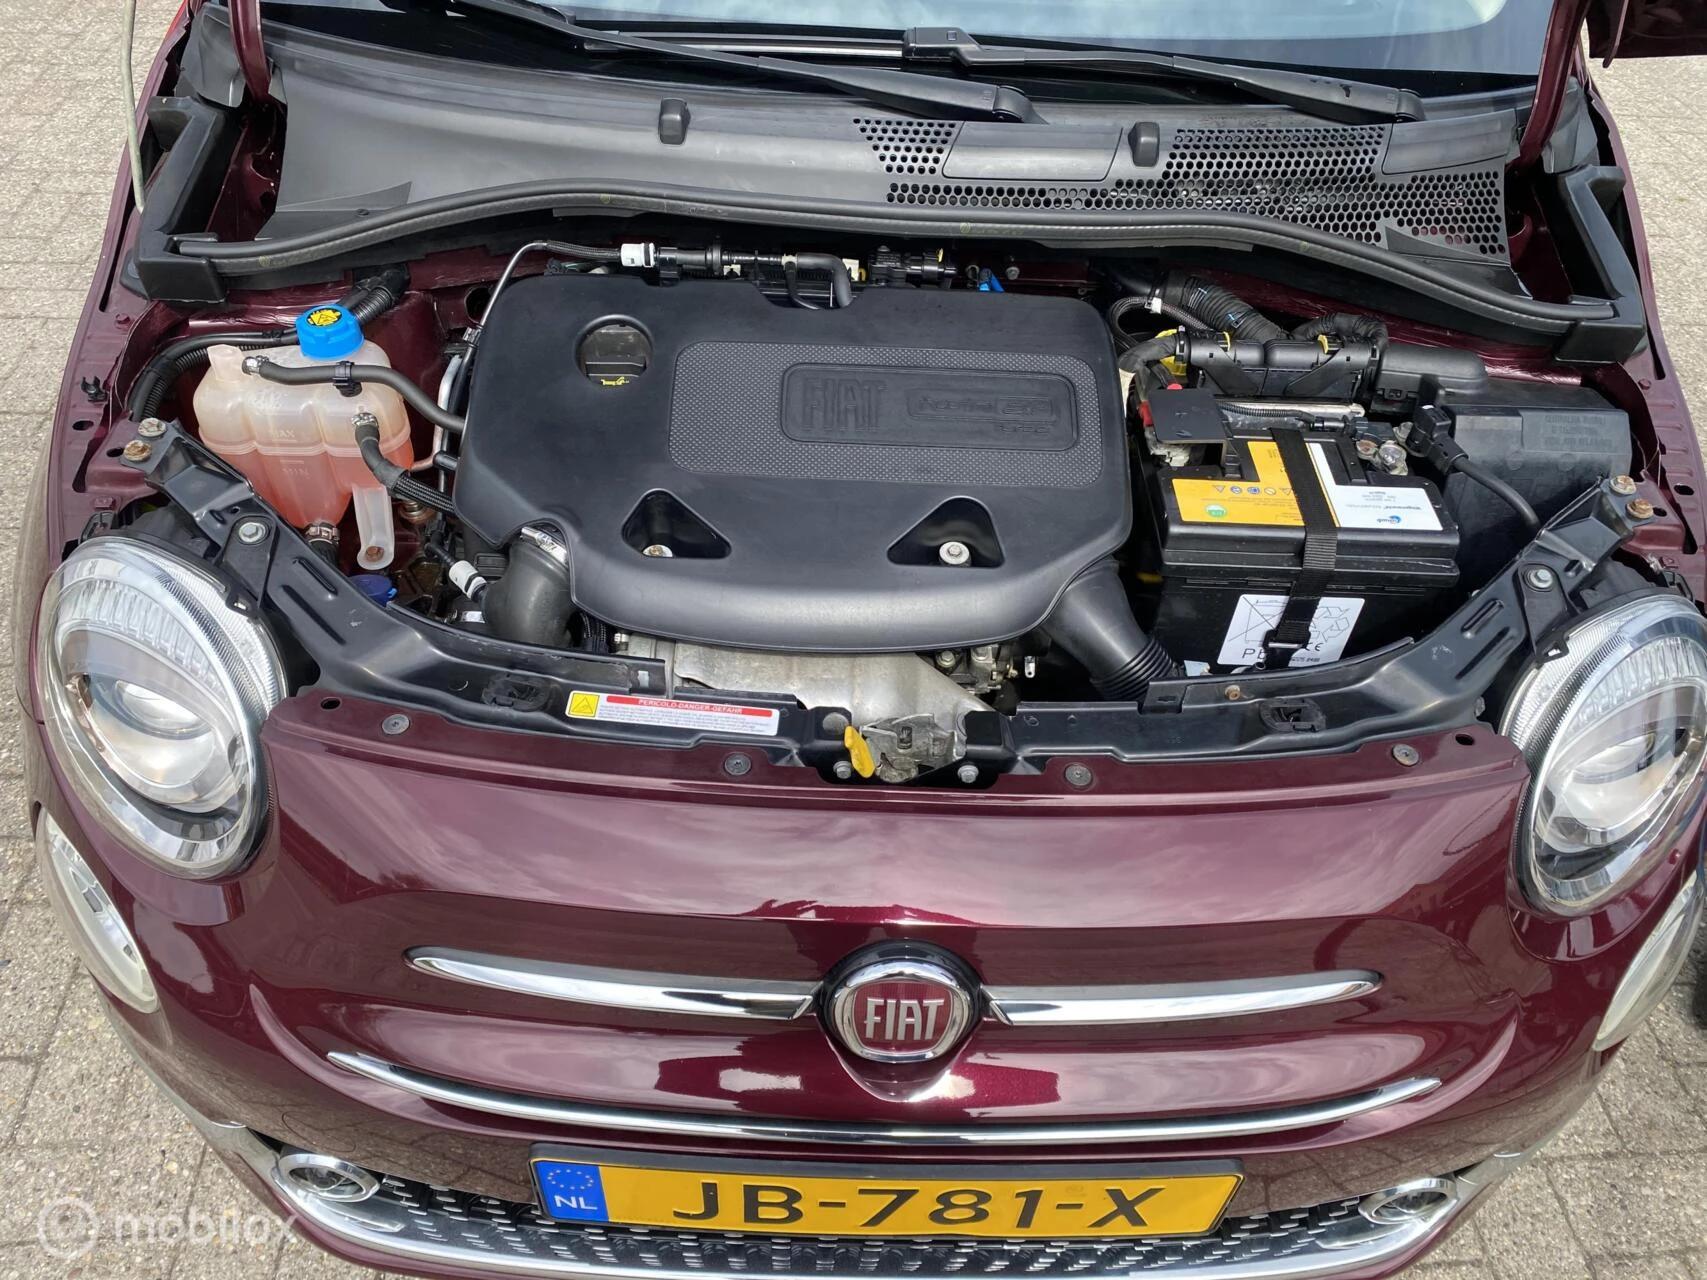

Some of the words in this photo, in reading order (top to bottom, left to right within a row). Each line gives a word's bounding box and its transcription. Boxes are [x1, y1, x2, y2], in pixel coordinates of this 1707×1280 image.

[803, 378, 887, 432] FIAT
[864, 997, 944, 1041] FIAT
[555, 1192, 597, 1211] NL
[673, 1181, 1164, 1229] JB-781-X
